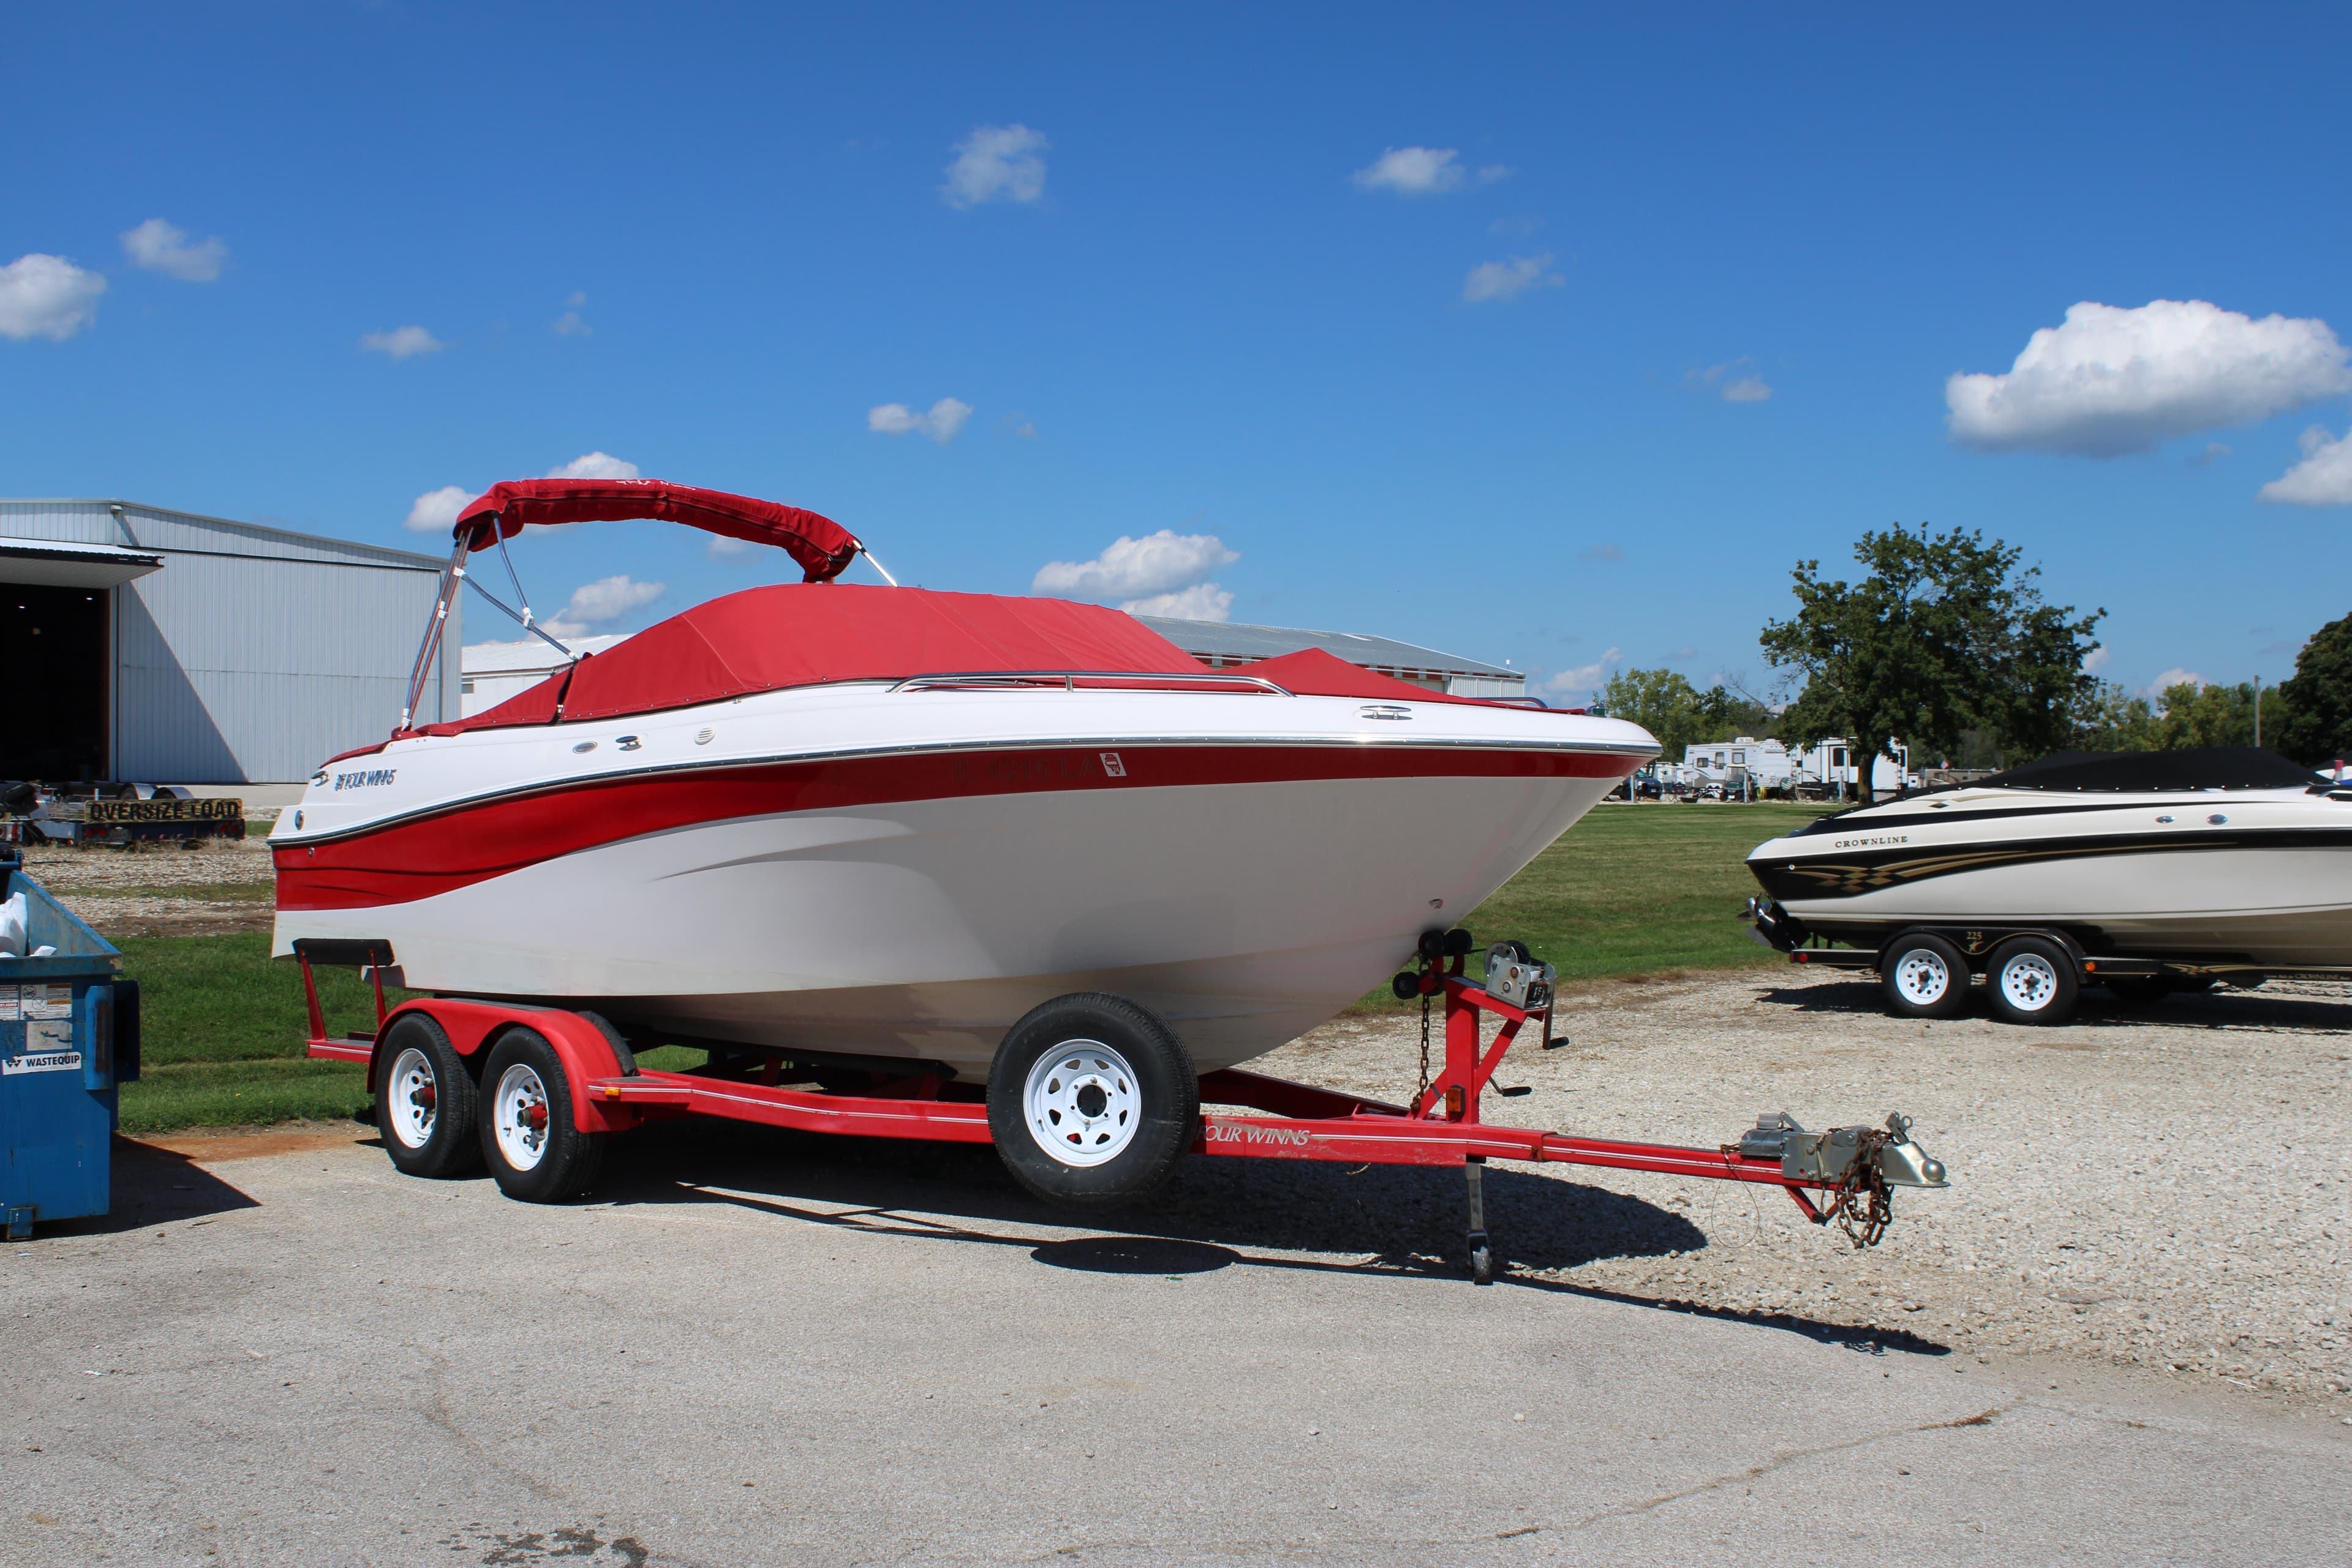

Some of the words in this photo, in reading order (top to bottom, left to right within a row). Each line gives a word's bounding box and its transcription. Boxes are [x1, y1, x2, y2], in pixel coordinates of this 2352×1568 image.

[90, 802, 184, 821] OVERSIZE
[190, 801, 238, 818] LOAD
[1835, 836, 1908, 848] CROWNLINE
[1967, 931, 1983, 940] 225
[26, 1055, 80, 1067] WASTEQUIP
[1246, 1128, 1310, 1147] WINNS
